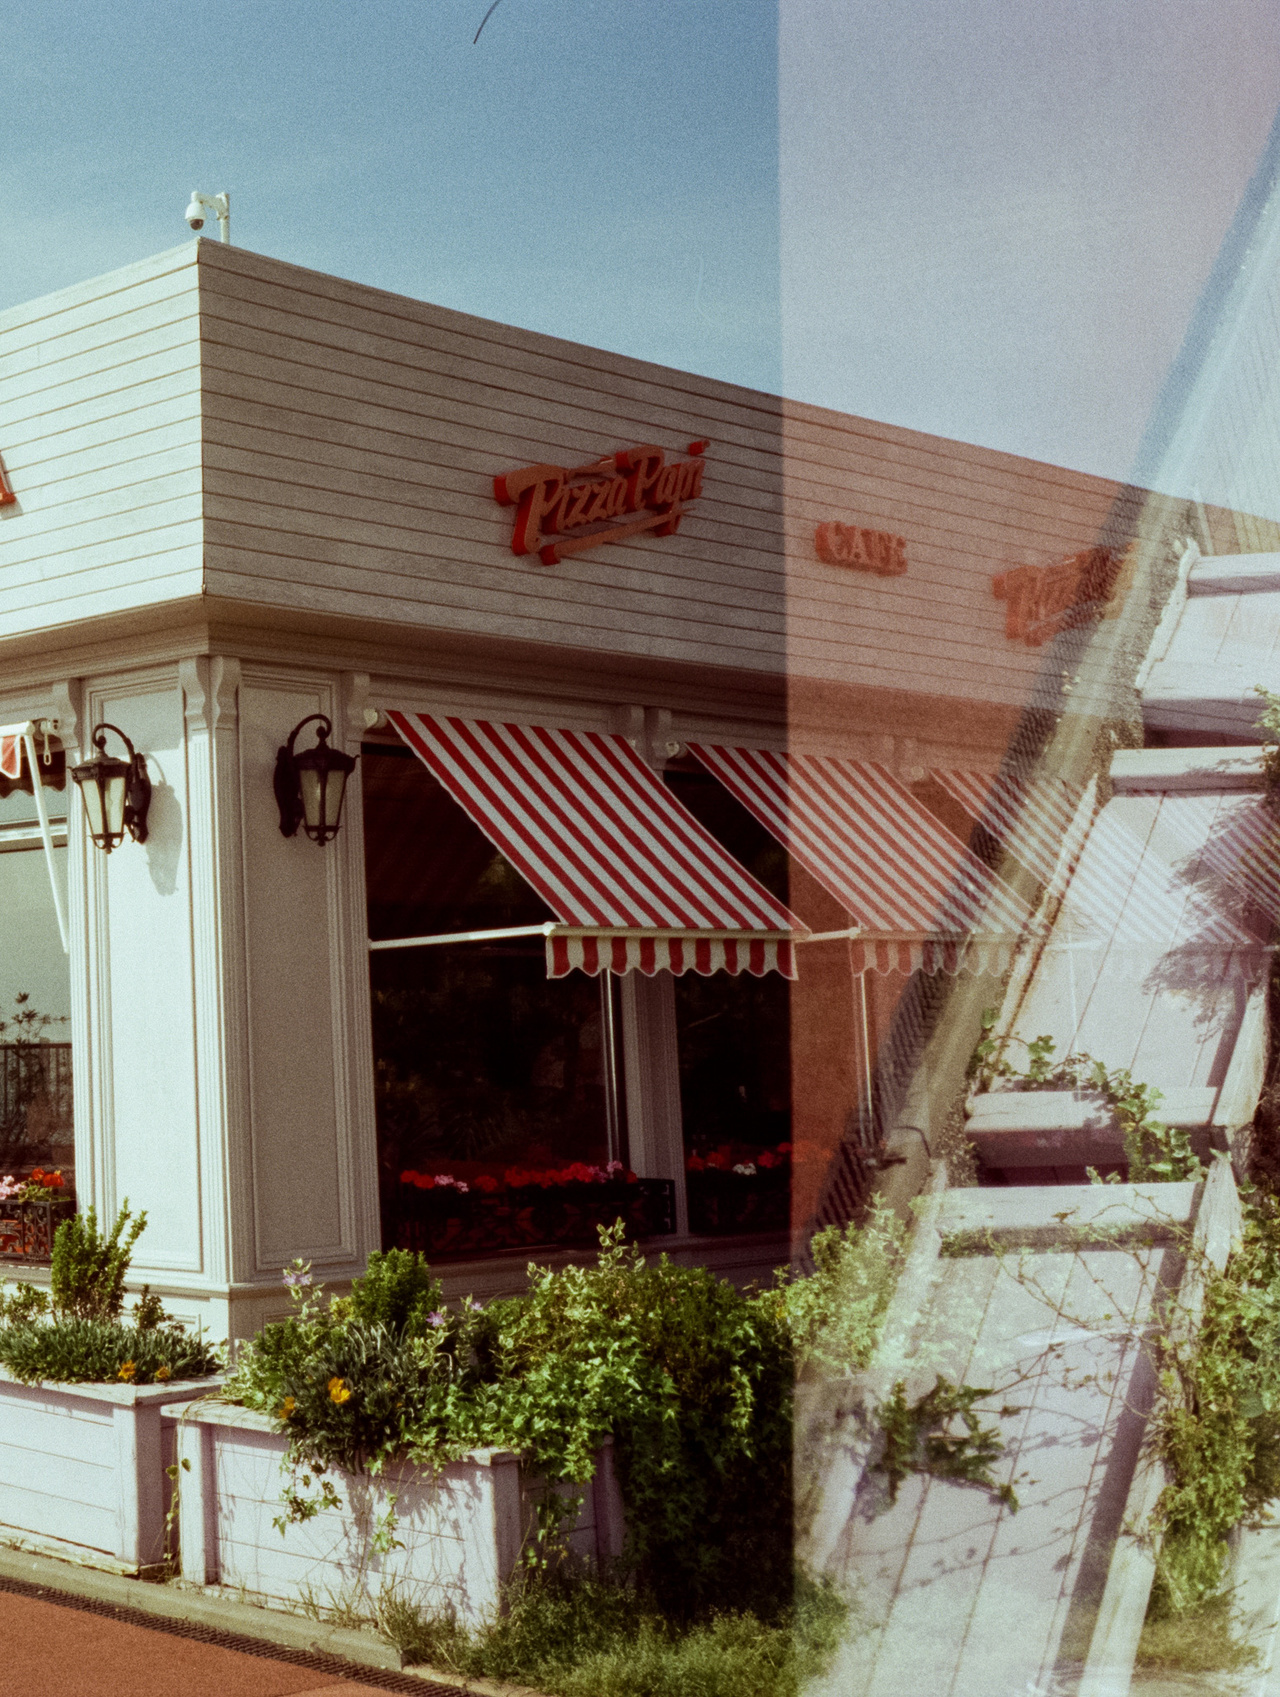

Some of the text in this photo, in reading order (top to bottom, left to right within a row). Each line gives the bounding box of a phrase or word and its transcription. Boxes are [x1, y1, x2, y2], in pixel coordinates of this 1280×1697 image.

[498, 440, 710, 556] Pizza Papi
[817, 521, 907, 576] CAFE
